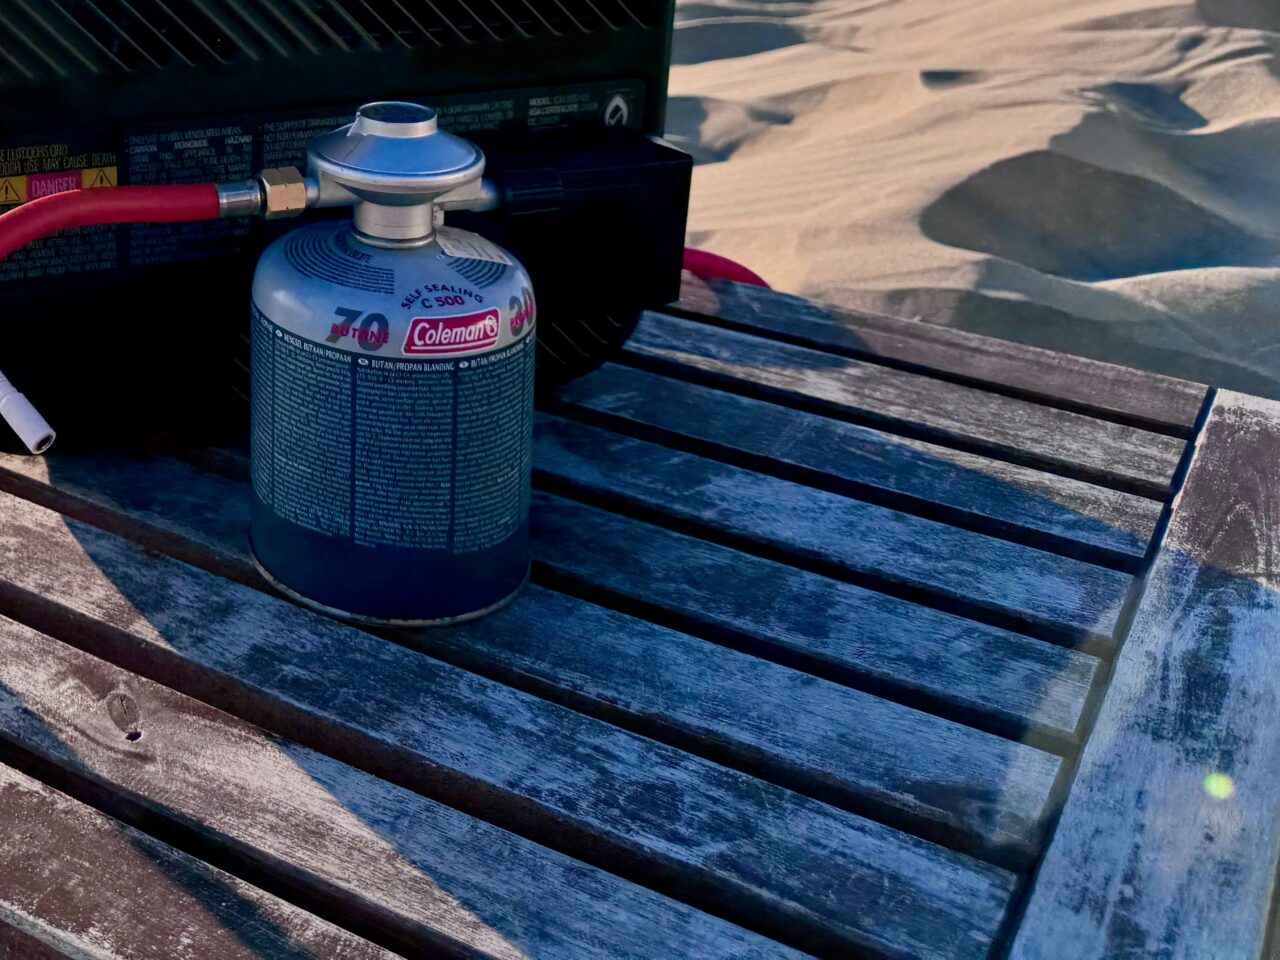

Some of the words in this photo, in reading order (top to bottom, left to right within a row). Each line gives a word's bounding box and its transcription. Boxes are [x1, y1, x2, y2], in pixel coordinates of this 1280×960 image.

[24, 158, 39, 172] USE
[43, 156, 61, 171] MAY
[64, 153, 88, 168] CAUSE
[92, 152, 116, 165] DEATH
[31, 177, 77, 198] DANGER
[401, 289, 423, 310] SELF
[424, 283, 484, 304] SEALING
[421, 298, 433, 309] C
[434, 295, 465, 307] 500
[325, 306, 389, 351] 70
[331, 323, 390, 345] BUTANE
[413, 319, 484, 346] Coleman
[371, 359, 423, 372] BUTAN/PROPAN
[423, 361, 456, 372] BLANDING
